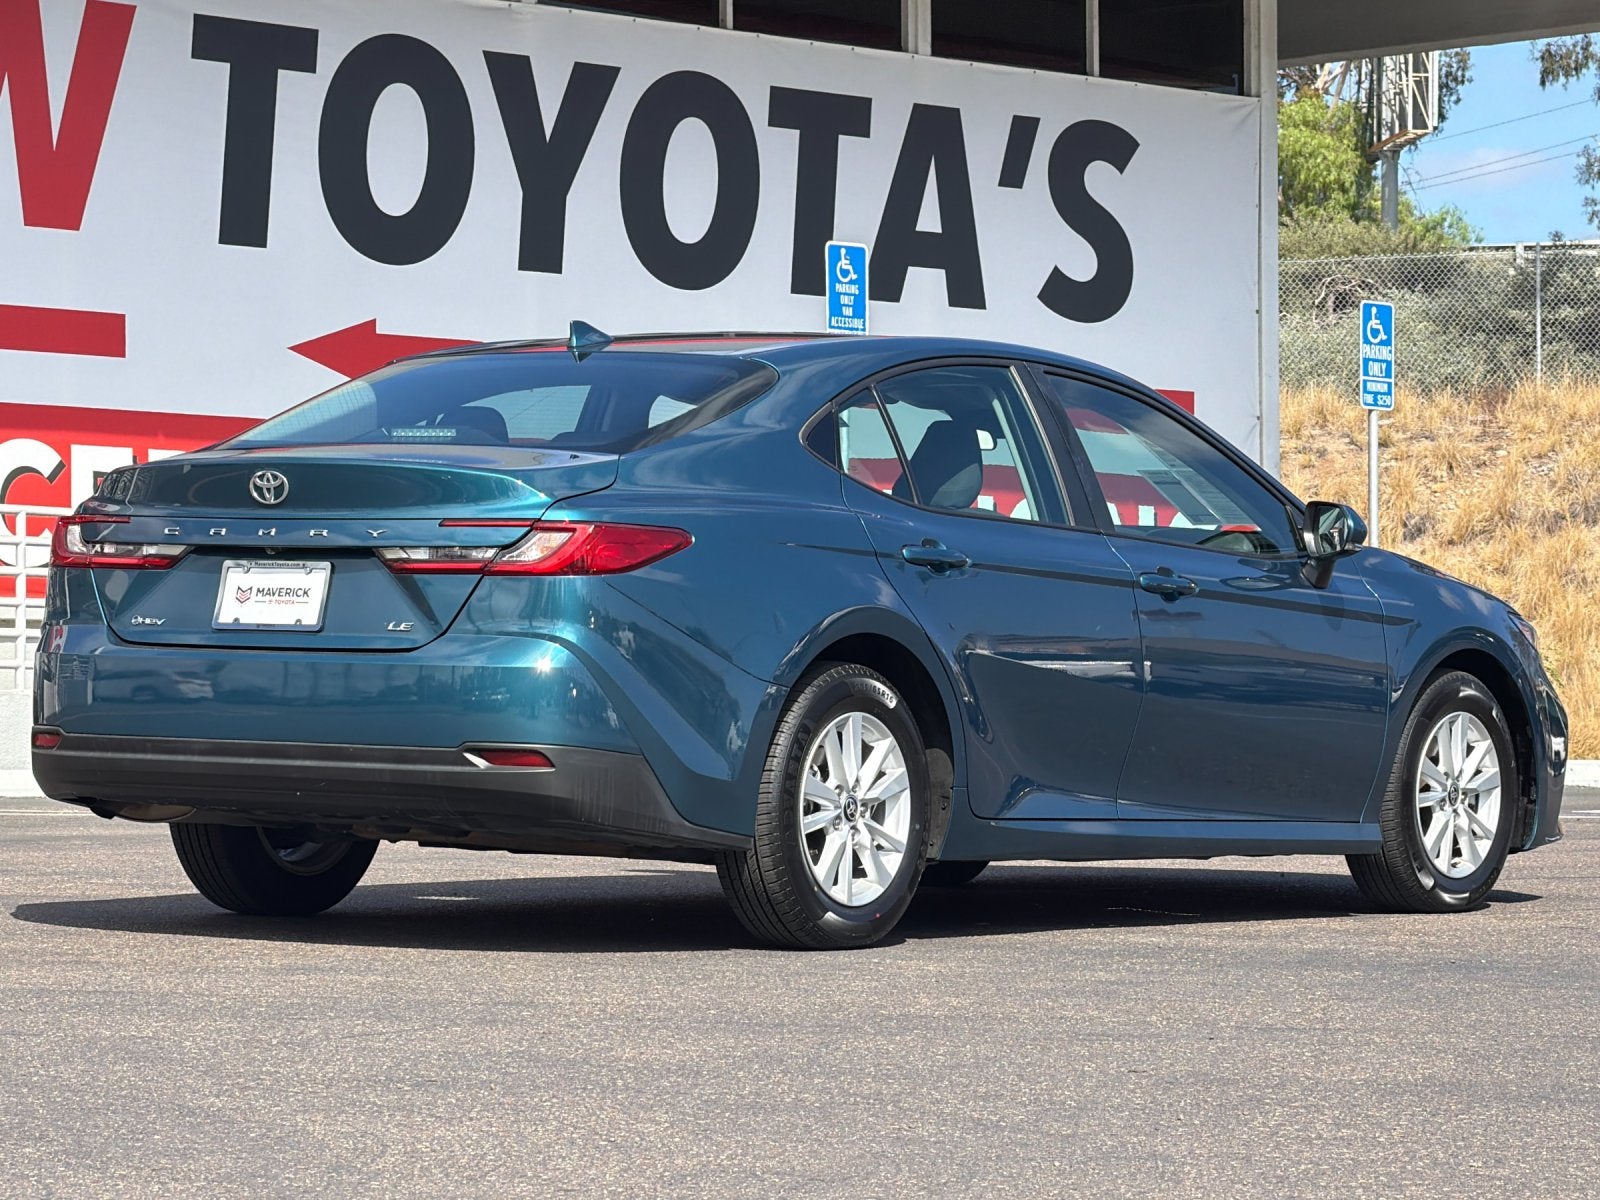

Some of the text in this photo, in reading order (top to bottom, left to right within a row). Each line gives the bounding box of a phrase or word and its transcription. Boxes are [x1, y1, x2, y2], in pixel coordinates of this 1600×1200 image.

[191, 14, 1140, 323] TOYOTA'S
[835, 283, 859, 295] PARKING
[840, 294, 855, 306] ONLY
[842, 306, 853, 317] VAN
[831, 316, 865, 329] ACCESSIBLE
[1362, 343, 1392, 361] PARKING
[1368, 361, 1387, 377] ONLY
[163, 526, 388, 538] CAMRY
[255, 587, 312, 598] MAVERICK
[387, 621, 415, 631] LE
